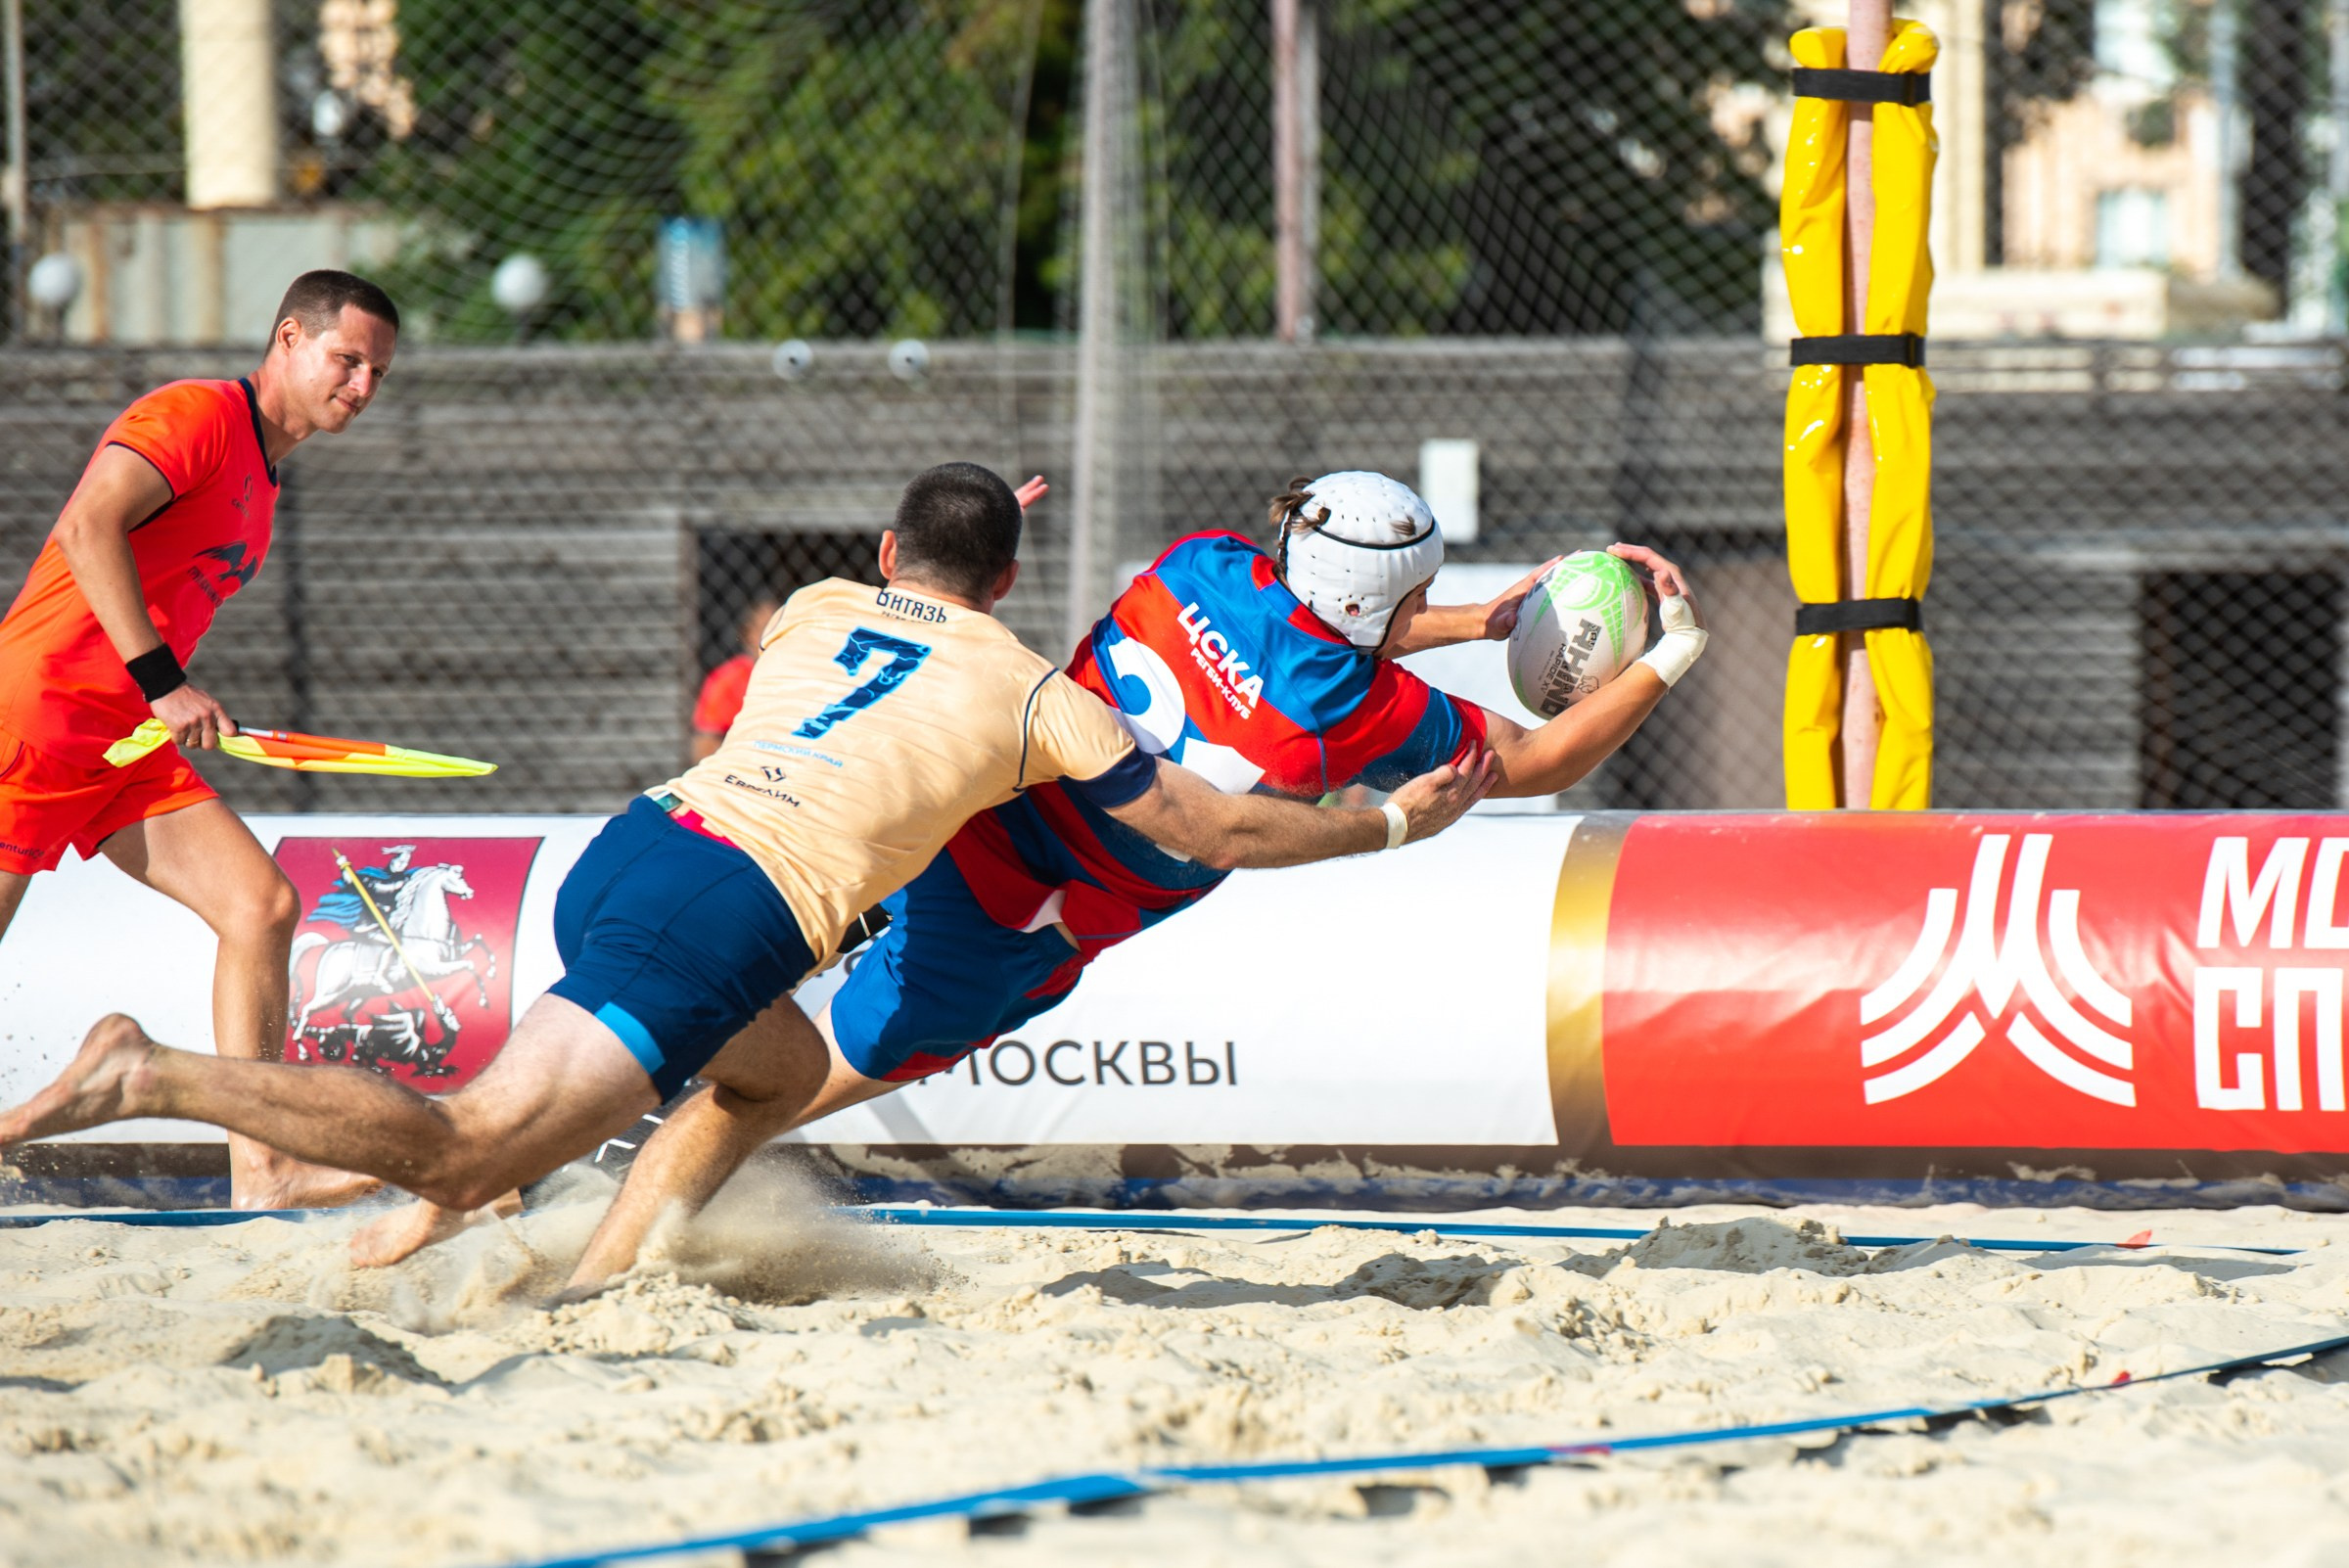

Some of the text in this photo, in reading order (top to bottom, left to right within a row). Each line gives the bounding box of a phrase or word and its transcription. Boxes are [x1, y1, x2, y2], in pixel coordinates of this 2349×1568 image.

[791, 625, 932, 740] 7
[1176, 601, 1265, 709] ЦСКА
[1190, 647, 1252, 719] РЕГБИ-КЛУБ
[1546, 643, 1567, 680] RAPIDE
[2193, 967, 2346, 1112] СП
